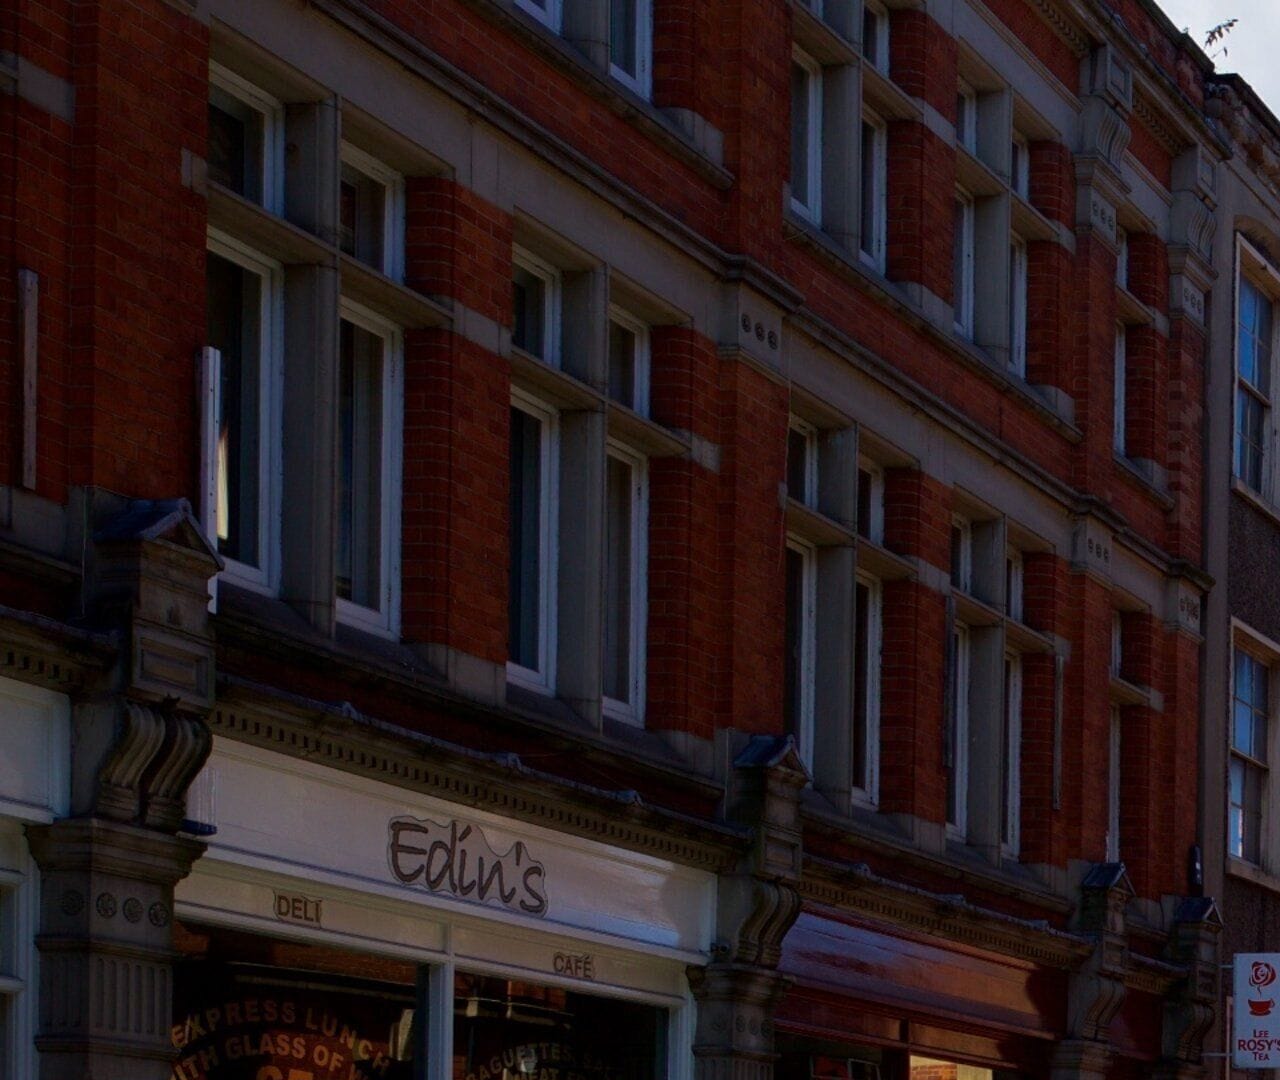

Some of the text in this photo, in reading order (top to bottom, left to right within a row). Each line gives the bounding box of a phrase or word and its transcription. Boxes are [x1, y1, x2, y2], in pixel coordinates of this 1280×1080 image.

[277, 894, 321, 923] DELI
[553, 954, 592, 978] CAFÉ
[170, 999, 297, 1049] EXPRESS
[225, 1033, 307, 1060] GLASS
[312, 1044, 345, 1072] OF
